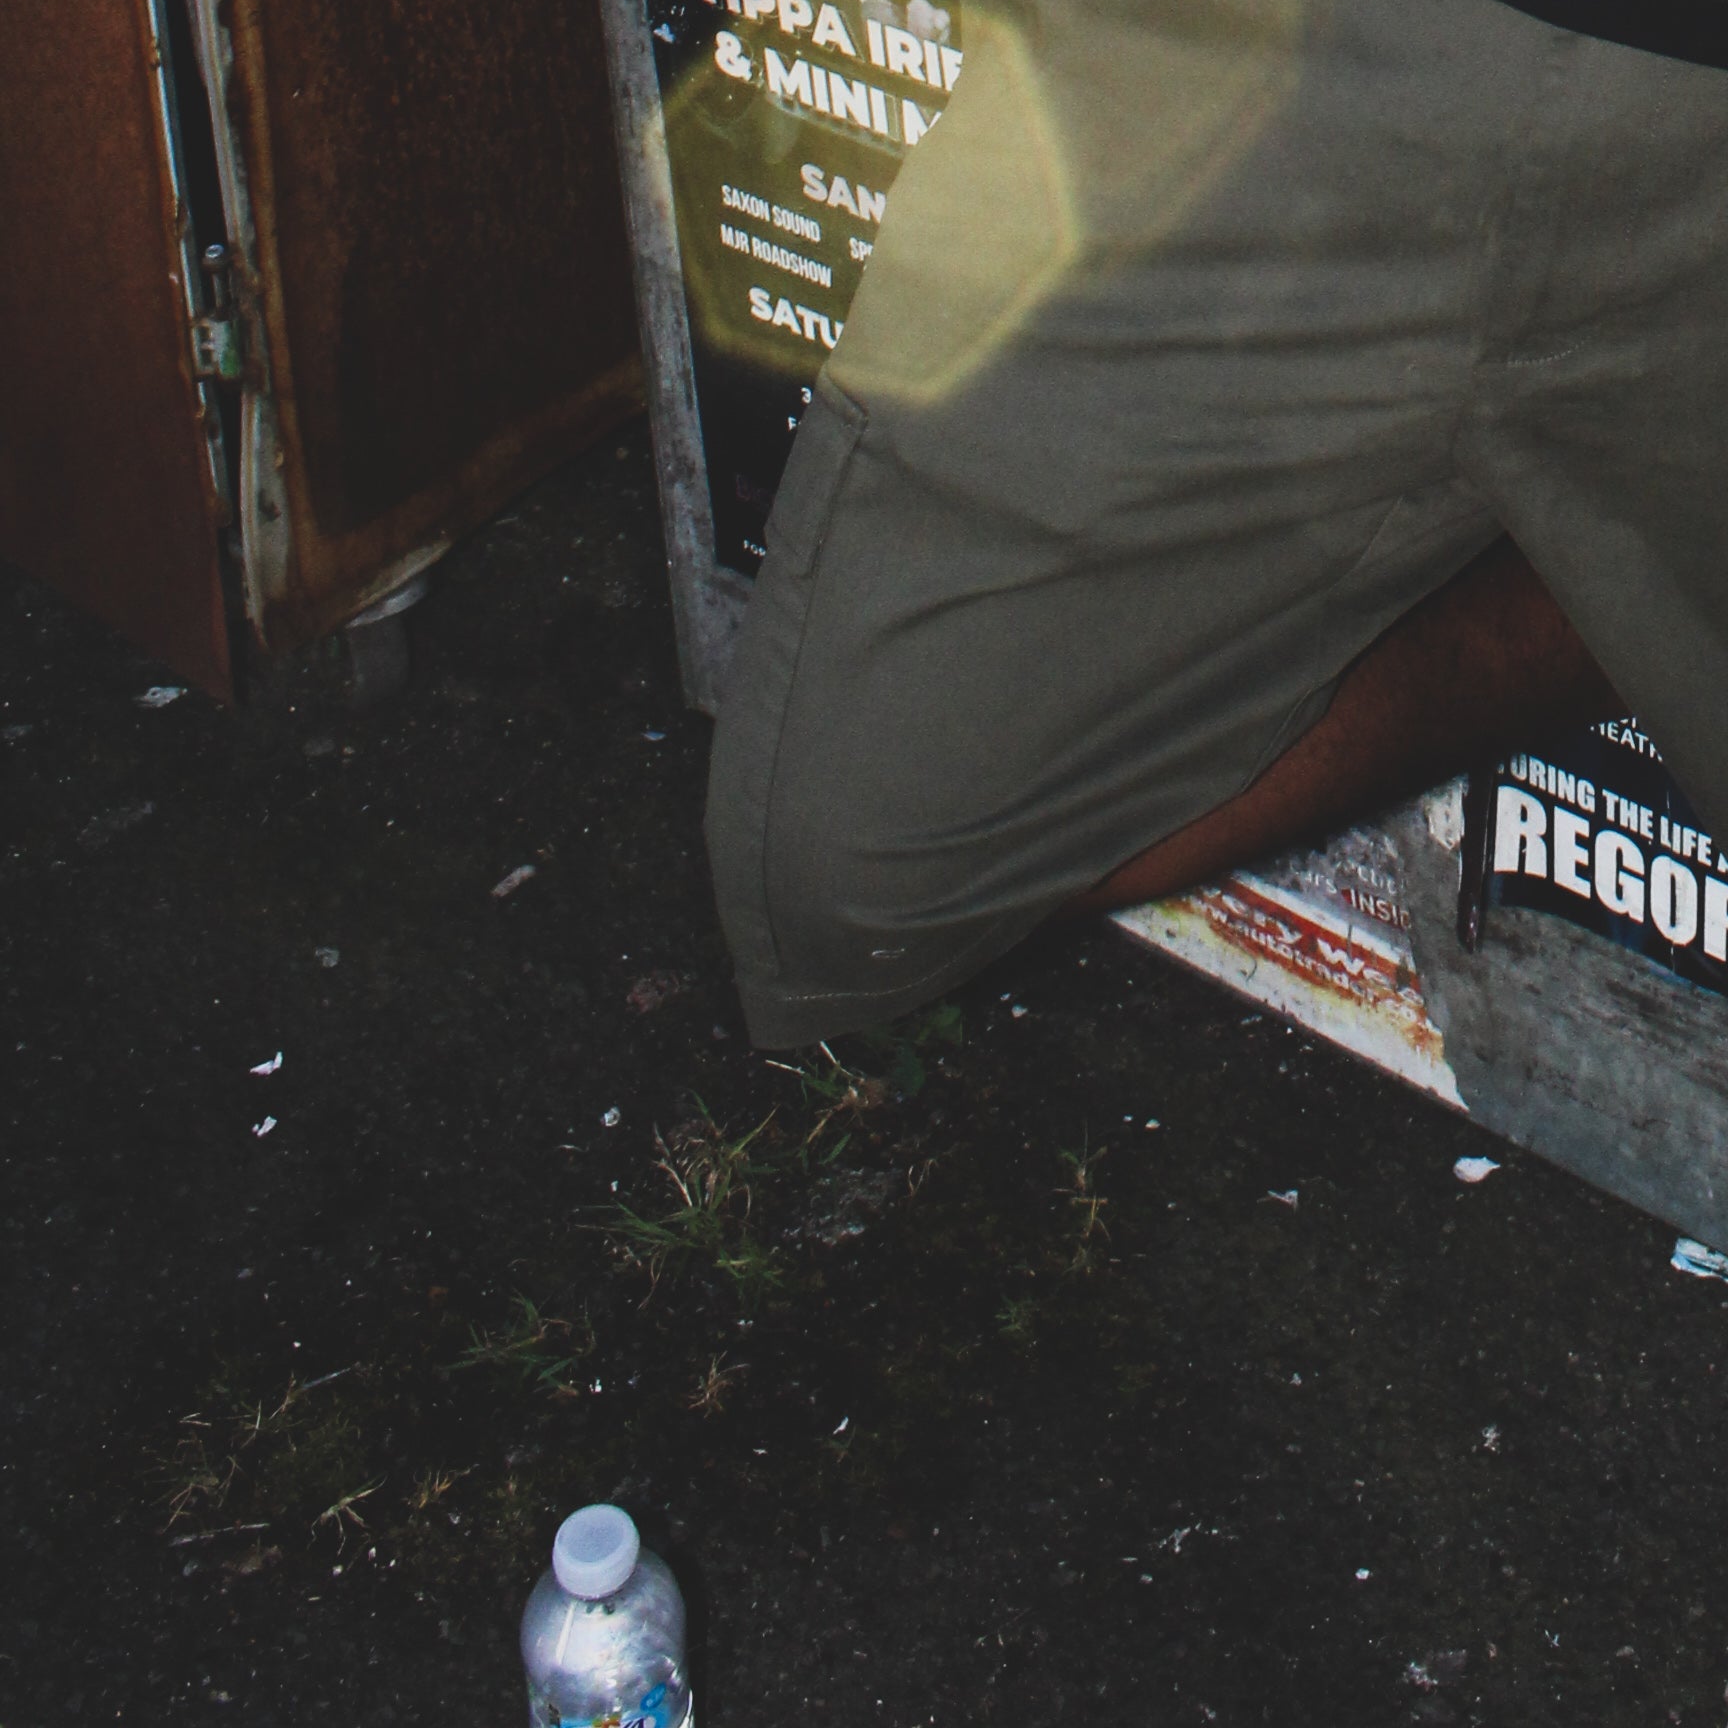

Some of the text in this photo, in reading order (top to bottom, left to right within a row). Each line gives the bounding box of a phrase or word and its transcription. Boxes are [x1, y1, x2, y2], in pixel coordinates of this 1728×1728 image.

[714, 29, 753, 82] &
[763, 46, 889, 135] MINI
[721, 184, 822, 243] SAXON SOUND
[720, 223, 750, 254] MJR
[752, 236, 832, 288] ROADSHOW
[749, 286, 845, 350] SATU
[1600, 787, 1655, 840] THE
[1659, 815, 1713, 868] LIFE
